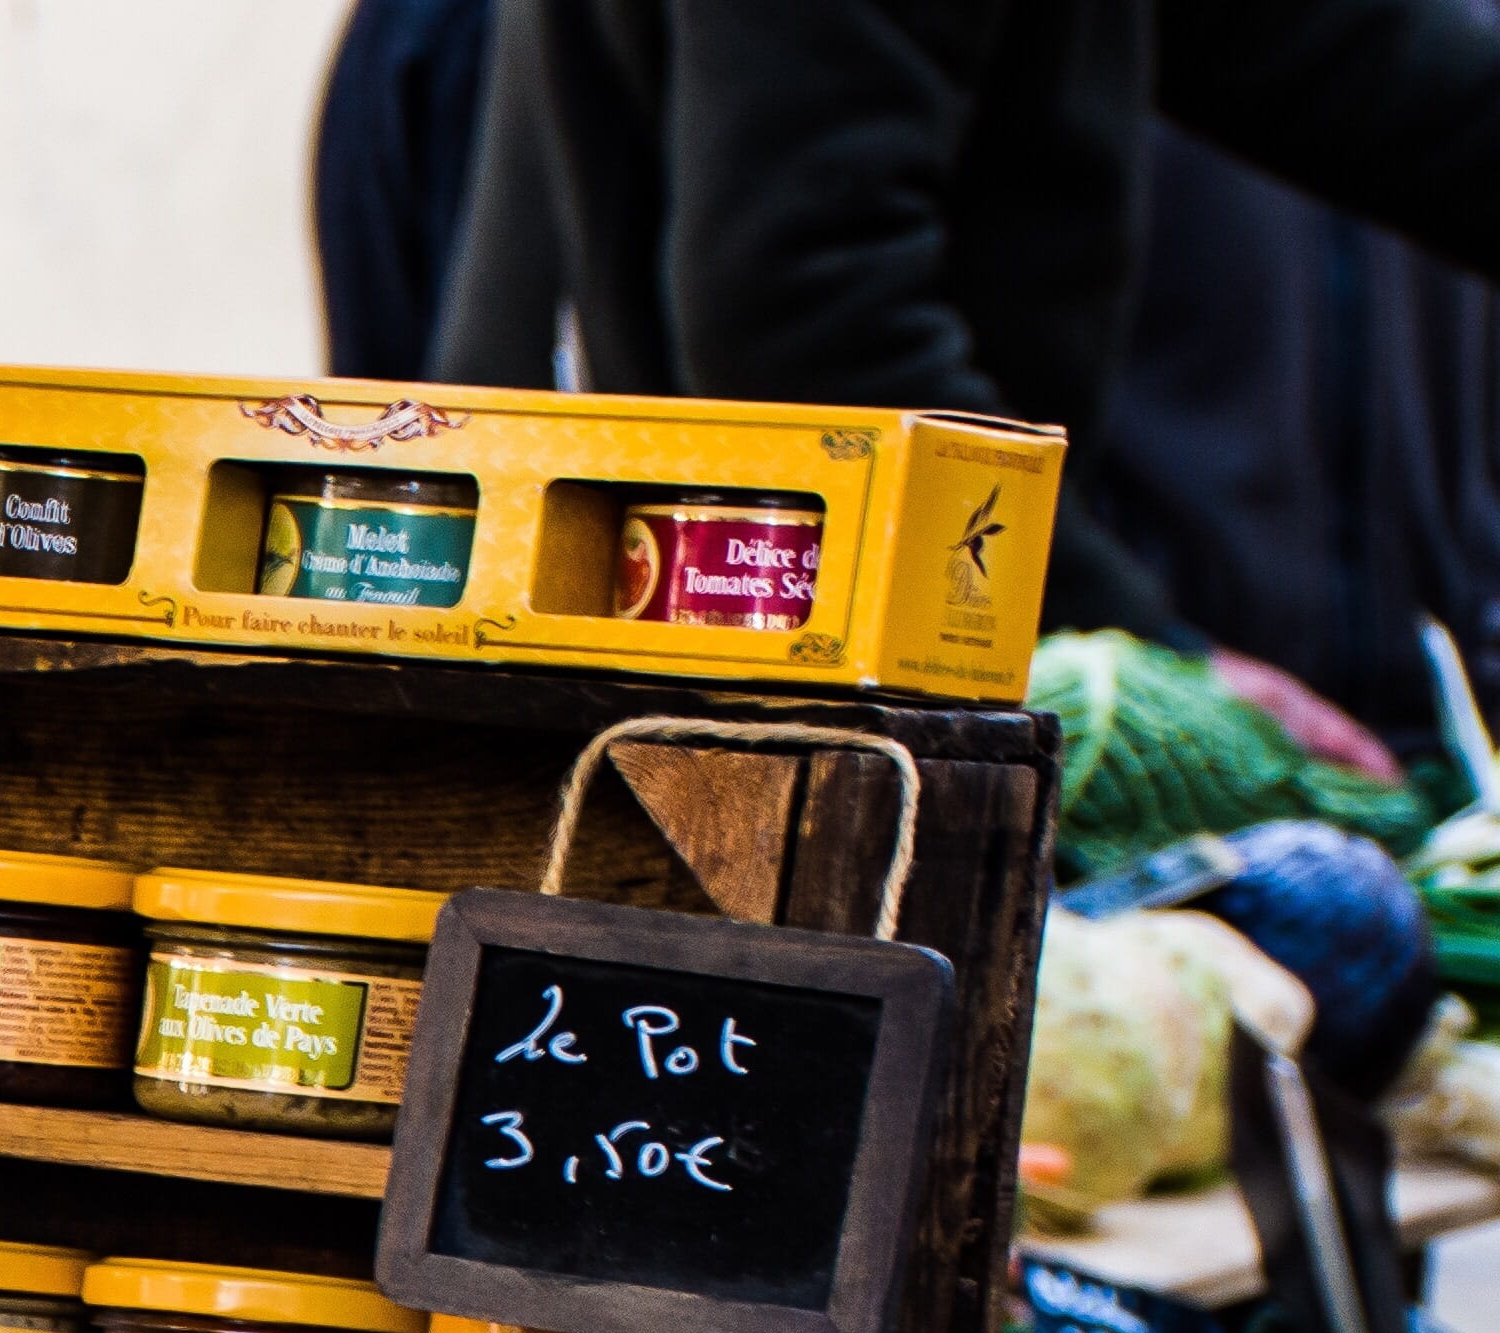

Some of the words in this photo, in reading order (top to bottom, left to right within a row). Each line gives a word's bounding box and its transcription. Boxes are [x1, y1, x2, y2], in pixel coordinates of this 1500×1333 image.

[6, 495, 70, 524] Confit
[347, 525, 408, 553] Melet
[725, 538, 797, 569] Délice
[684, 566, 774, 598] Tomates
[183, 607, 235, 632] Pour
[242, 610, 290, 634] faire
[299, 615, 382, 642] chanter
[388, 619, 408, 641] le
[413, 622, 469, 646] soleil
[173, 984, 259, 1018] Tapenade
[266, 994, 323, 1025] Verte
[187, 1015, 246, 1047] Olives
[252, 1026, 280, 1049] de
[286, 1029, 337, 1061] Pays
[496, 984, 586, 1062] Le
[623, 1005, 756, 1079] Pot
[481, 1110, 732, 1192] 3,50€
